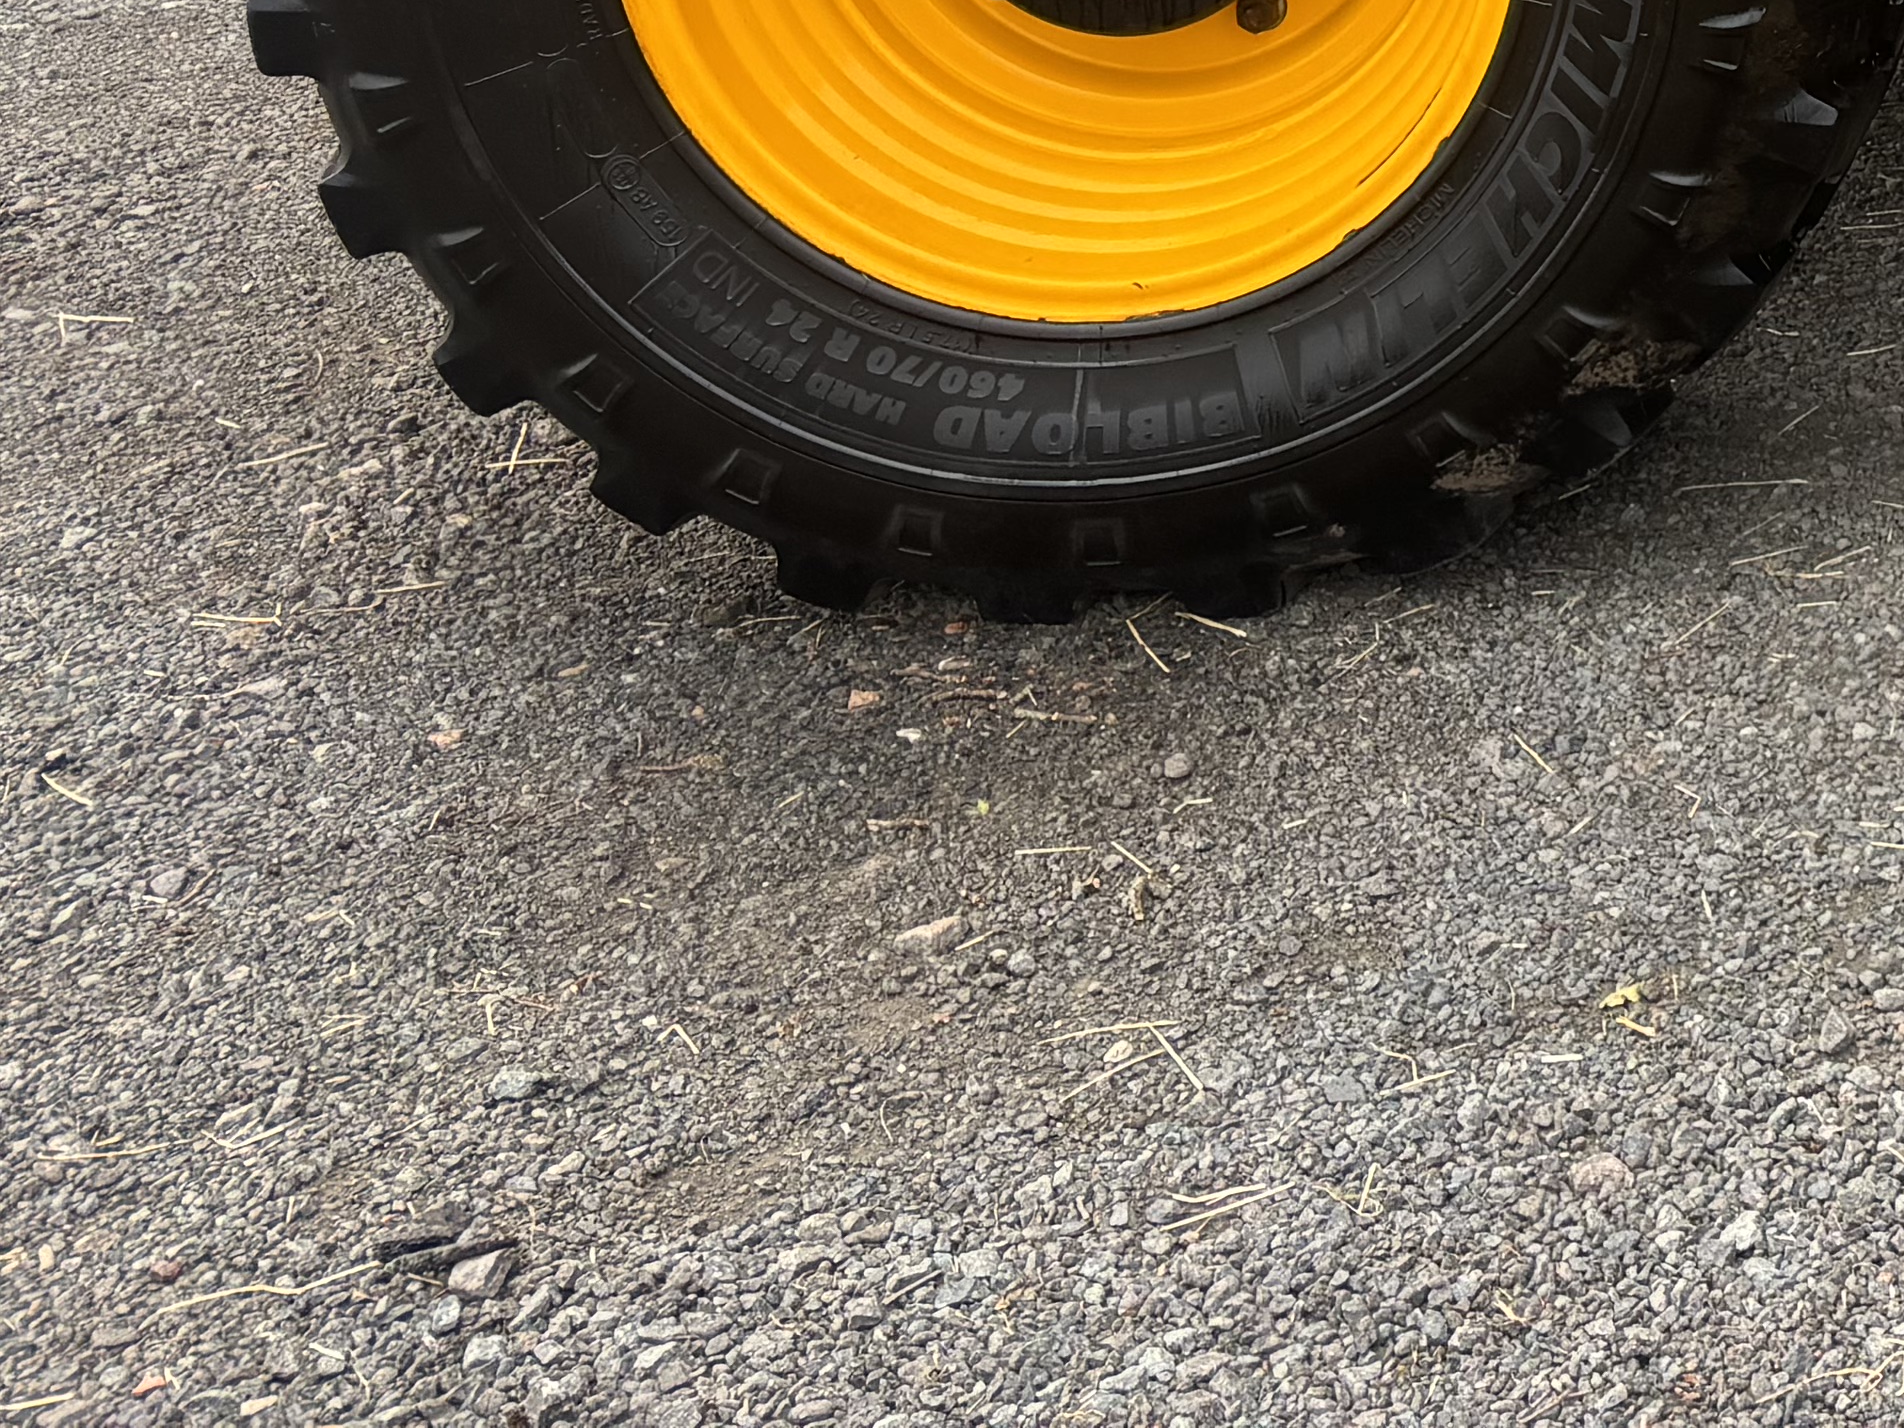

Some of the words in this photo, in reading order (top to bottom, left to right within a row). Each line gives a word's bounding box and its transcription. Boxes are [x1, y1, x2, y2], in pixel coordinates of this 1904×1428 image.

[690, 246, 763, 308] IND
[652, 278, 809, 385] SURFACE
[762, 296, 823, 345] 24
[822, 322, 854, 364] R
[803, 370, 908, 426] HARD
[865, 344, 1027, 404] 460/70
[932, 390, 1247, 456] BIBLOAD
